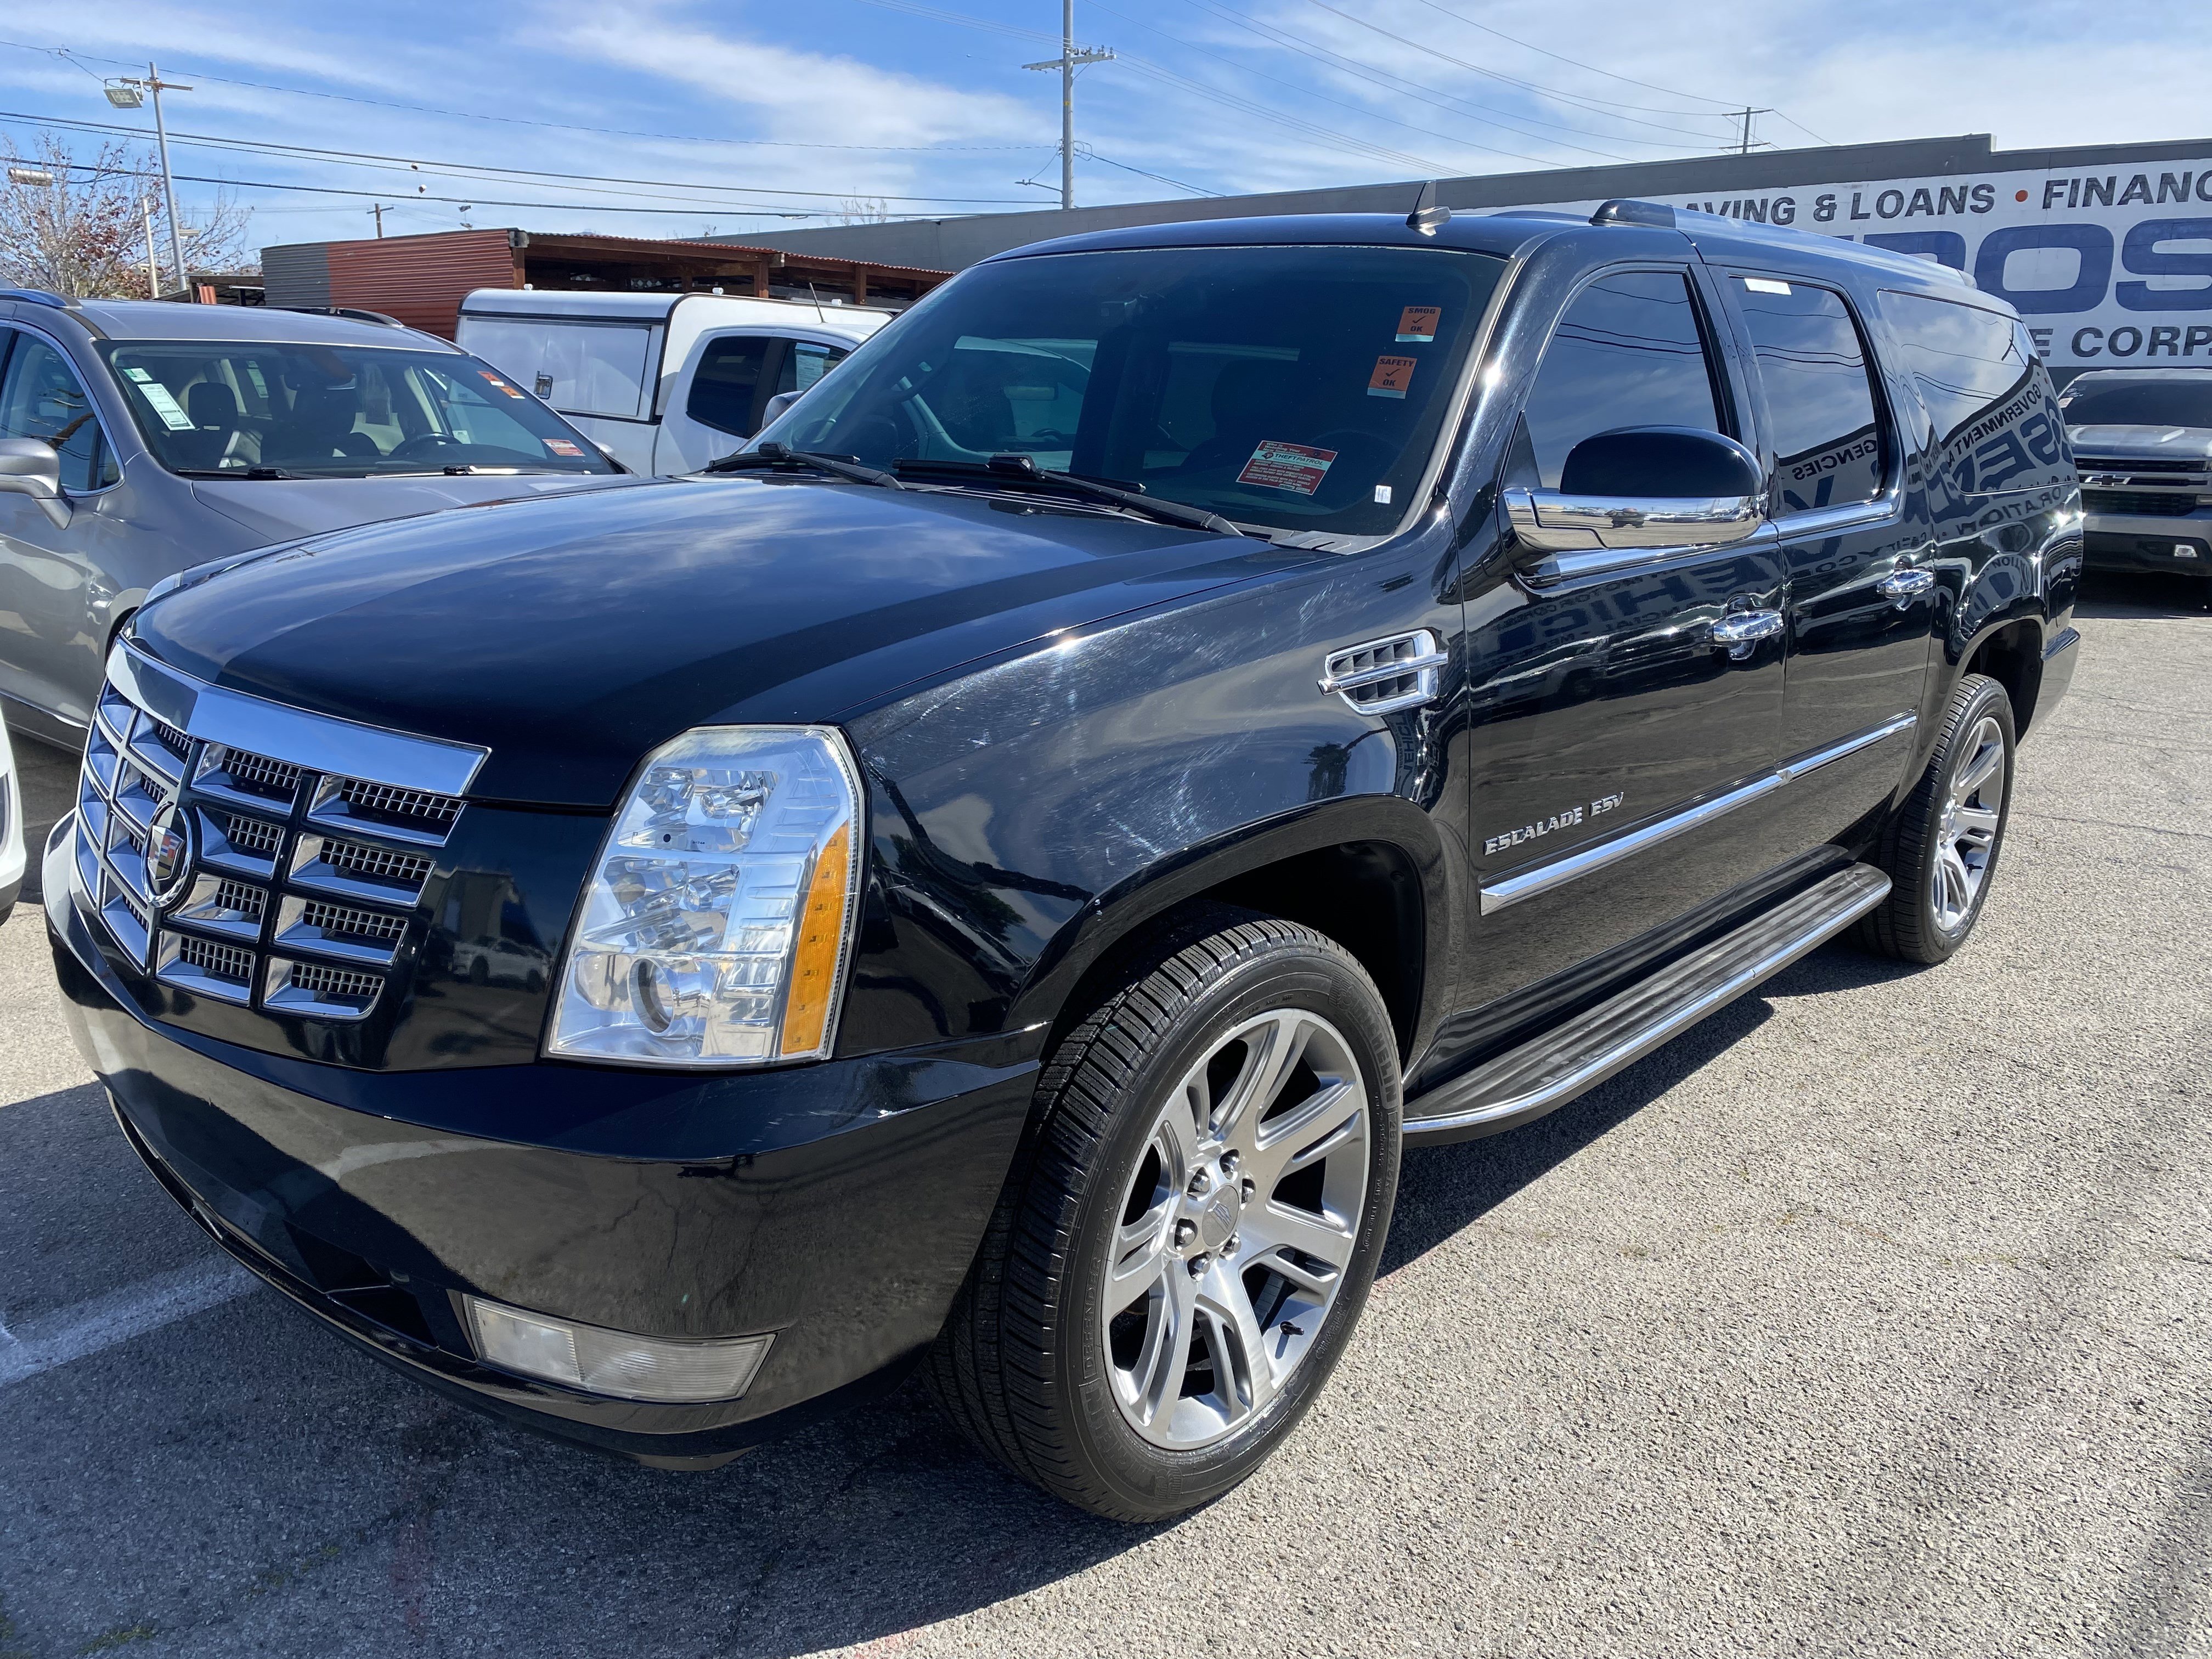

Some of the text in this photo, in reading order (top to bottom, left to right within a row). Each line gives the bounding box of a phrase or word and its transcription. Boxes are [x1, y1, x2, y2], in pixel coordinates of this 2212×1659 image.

[1813, 193, 1838, 222] &
[1850, 184, 1996, 220] LOANS
[1379, 358, 1414, 366] SAFETY
[1484, 792, 1624, 855] ESCALADE ESV
[1350, 1000, 1397, 1103] MICHELIN
[1084, 1259, 1101, 1368] DEFENDER
